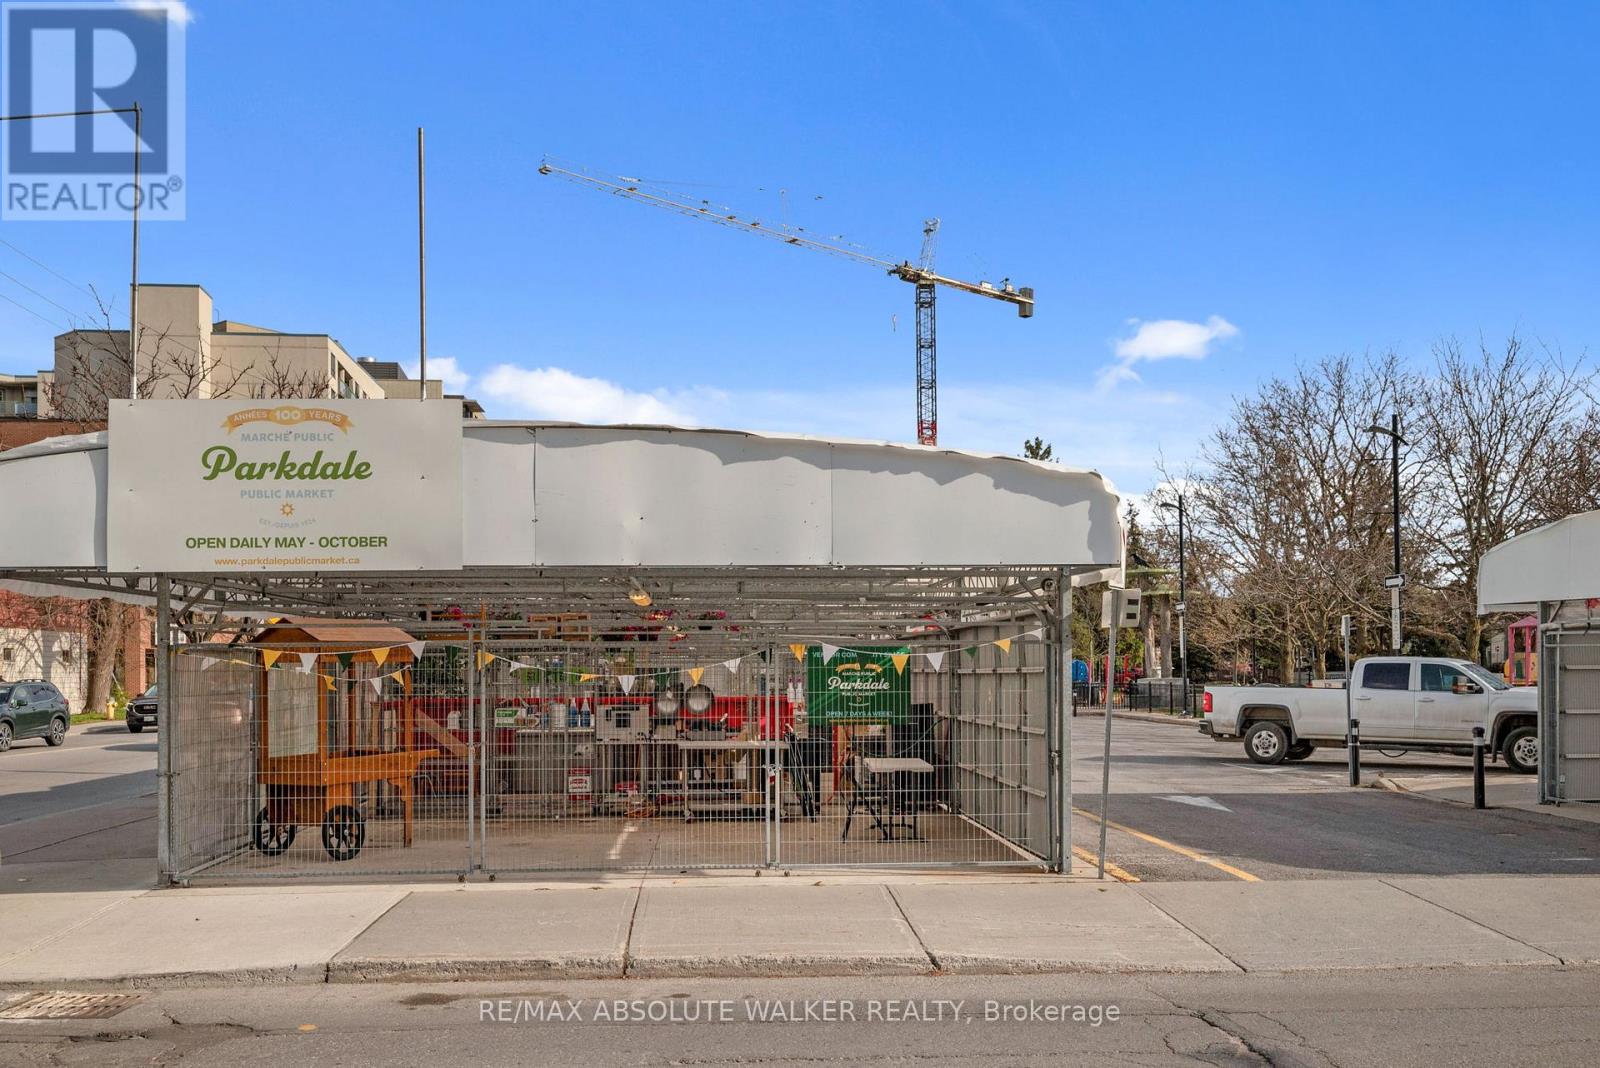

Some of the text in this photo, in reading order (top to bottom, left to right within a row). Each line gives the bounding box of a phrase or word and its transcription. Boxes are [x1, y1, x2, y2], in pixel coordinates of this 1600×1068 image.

[275, 410, 301, 420] 100
[309, 410, 342, 422] YEARS
[294, 432, 334, 441] PUBLIC
[201, 445, 373, 481] Parkdale
[240, 489, 334, 499] PUBLIC MARKET
[185, 537, 226, 549] OPEN
[230, 537, 271, 548] DAILY
[274, 537, 306, 548] MAY
[318, 536, 388, 548] OCTOBER
[214, 556, 361, 566] www.parkdalepublicmarket.ca
[828, 676, 890, 690] Parkdale
